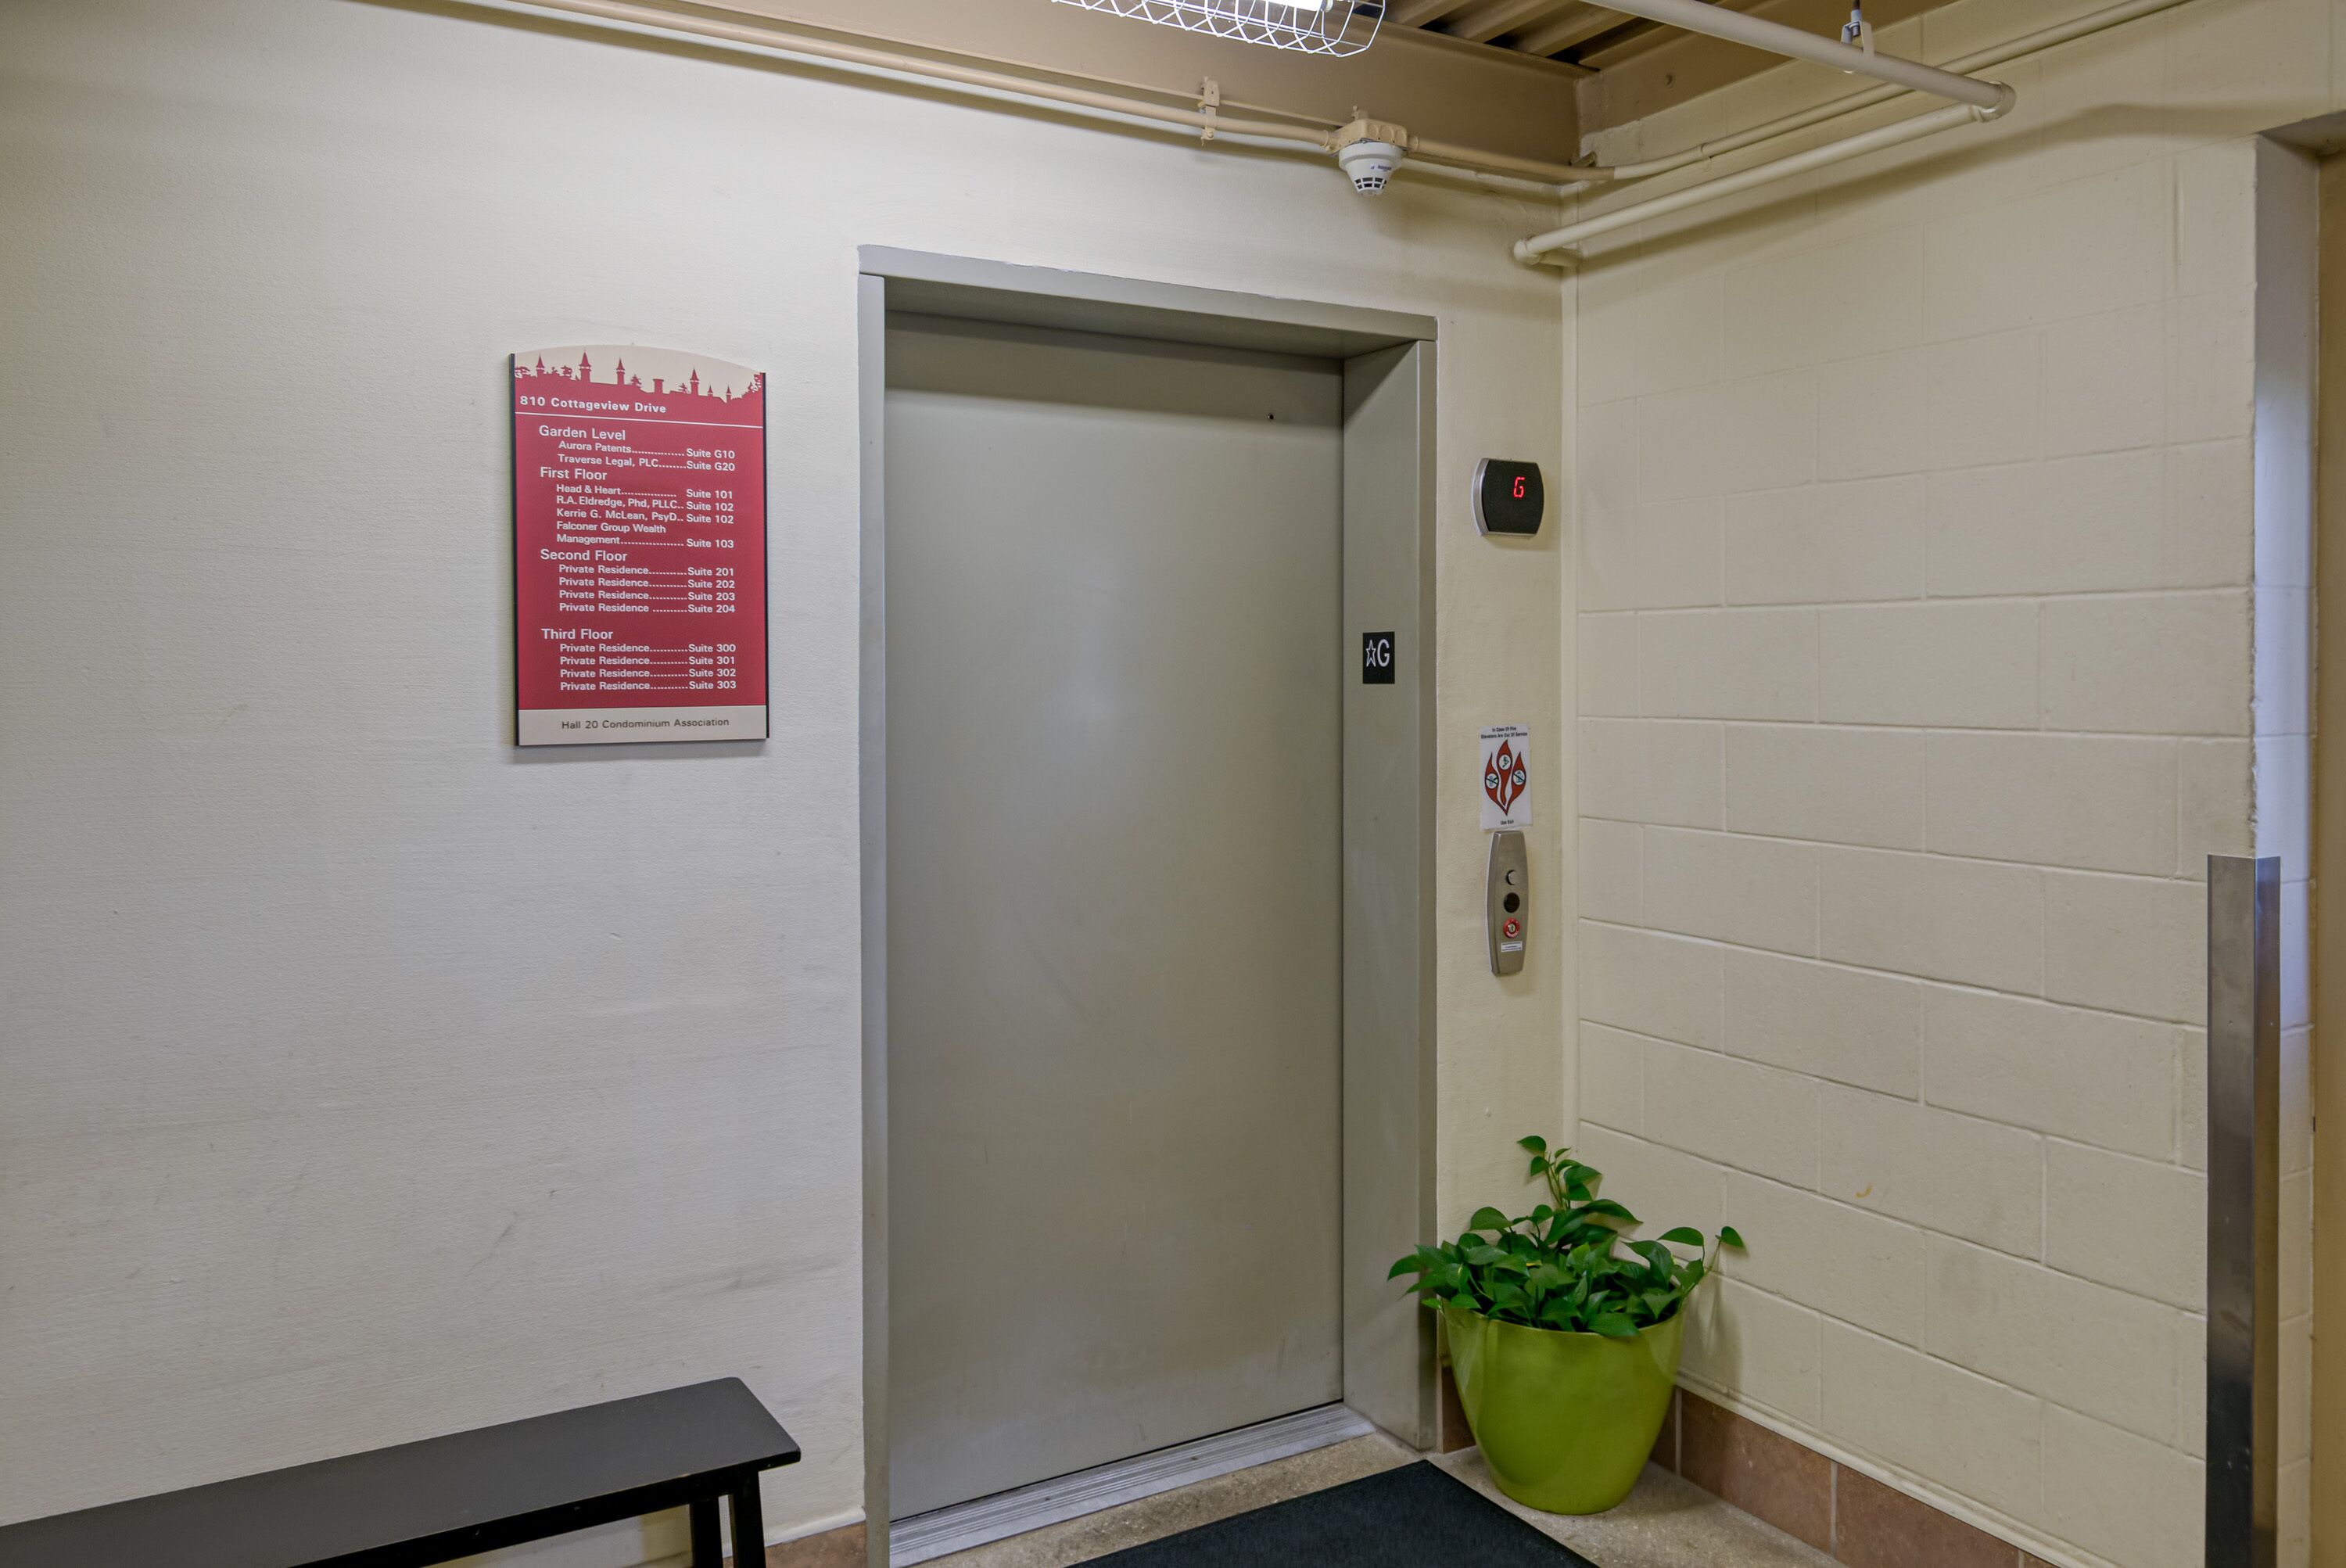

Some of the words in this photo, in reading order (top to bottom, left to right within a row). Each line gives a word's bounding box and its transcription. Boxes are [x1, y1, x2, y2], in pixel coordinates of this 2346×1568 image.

[520, 396, 546, 407] 810
[551, 397, 630, 413] Cottageview
[634, 403, 666, 413] Drive
[539, 425, 587, 439] Garden
[591, 428, 626, 440] Level
[558, 441, 592, 451] Aurora
[687, 448, 711, 458] Suite
[714, 450, 735, 459] G10
[558, 454, 602, 465] Traverse
[605, 456, 635, 468] Legal,
[687, 461, 711, 471] Suite
[714, 461, 735, 472] G20
[540, 467, 570, 479] First
[574, 468, 607, 480] Floor
[557, 484, 583, 494] Head
[585, 485, 592, 494] &
[687, 489, 711, 498] Suite
[715, 490, 733, 499] 101
[557, 496, 577, 505] R.A.
[579, 497, 626, 508] Eldredge,
[628, 498, 650, 508] Phd,
[687, 501, 711, 511] Suite
[715, 502, 734, 511] 102
[557, 509, 586, 518] Kerrie
[590, 510, 601, 519] G.
[605, 510, 647, 521] McLean,
[687, 513, 711, 523] Suite
[715, 515, 734, 524] 102
[557, 521, 597, 531] Falconer
[601, 522, 630, 533] Group
[633, 524, 665, 533] Wealth
[687, 538, 711, 548] Suite
[715, 540, 734, 548] 103
[540, 549, 590, 561] Second
[595, 551, 627, 562] Floor
[559, 565, 594, 574] Private
[687, 566, 712, 576] Suite
[716, 568, 734, 576] 201
[559, 577, 594, 587] Private
[687, 579, 712, 589] Suite
[716, 579, 734, 589] 202
[559, 590, 594, 599] Private
[687, 591, 712, 601] Suite
[716, 592, 734, 601] 203
[559, 603, 595, 612] Private
[598, 603, 649, 612] Residence
[688, 604, 713, 614] Suite
[716, 605, 735, 614] 204
[542, 629, 576, 640] Third
[580, 629, 613, 640] Floor
[560, 644, 595, 653] Private
[688, 644, 713, 653] Suite
[716, 644, 736, 653] 300
[1377, 638, 1390, 667] G
[560, 656, 595, 666] Private
[688, 656, 713, 666] Suite
[716, 656, 736, 666] 301
[560, 669, 595, 679] Private
[688, 669, 713, 678] Suite
[716, 669, 736, 677] 302
[560, 682, 595, 691] Private
[688, 680, 713, 691] Suite
[716, 680, 736, 690] 303
[561, 721, 580, 730] Hall
[586, 720, 598, 729] 20
[602, 719, 670, 729] Condominium
[674, 718, 729, 727] Association
